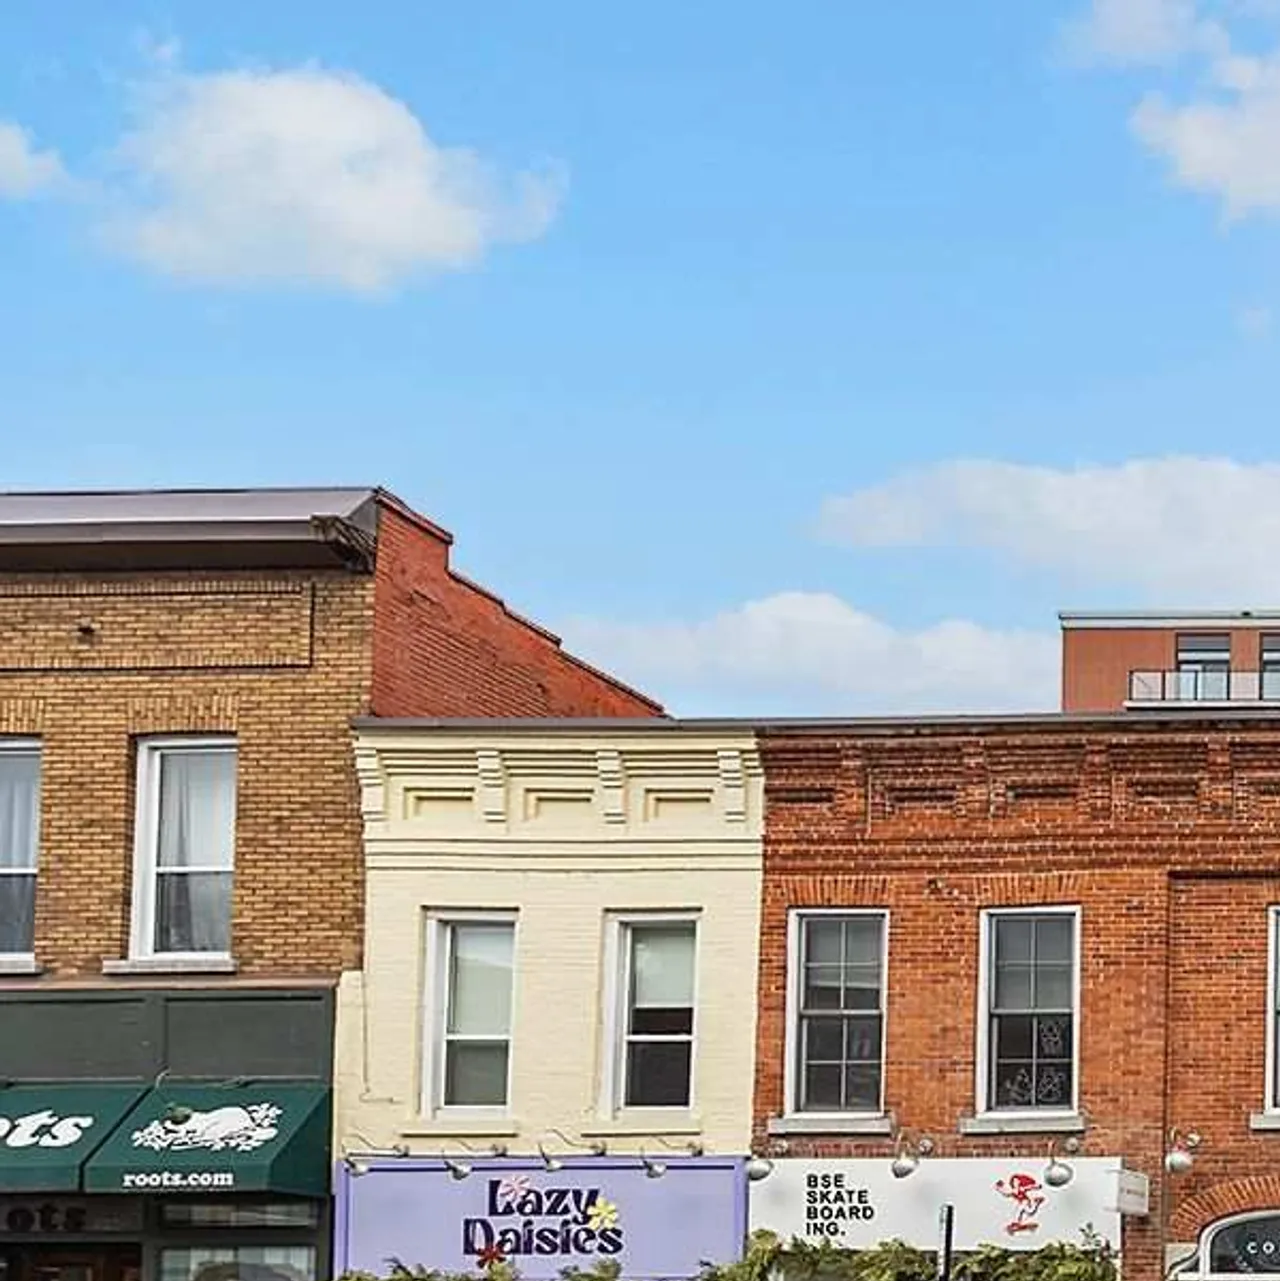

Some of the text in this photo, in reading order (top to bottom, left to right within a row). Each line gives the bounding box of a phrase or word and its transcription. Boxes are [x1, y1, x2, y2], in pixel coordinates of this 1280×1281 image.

[122, 1170, 234, 1187] roots.com
[806, 1173, 845, 1189] BSE
[488, 1179, 601, 1225] Lazy
[806, 1189, 869, 1204] SKATE
[806, 1205, 875, 1220] BOARD
[806, 1221, 846, 1236] ING.
[463, 1218, 624, 1256] Daisies
